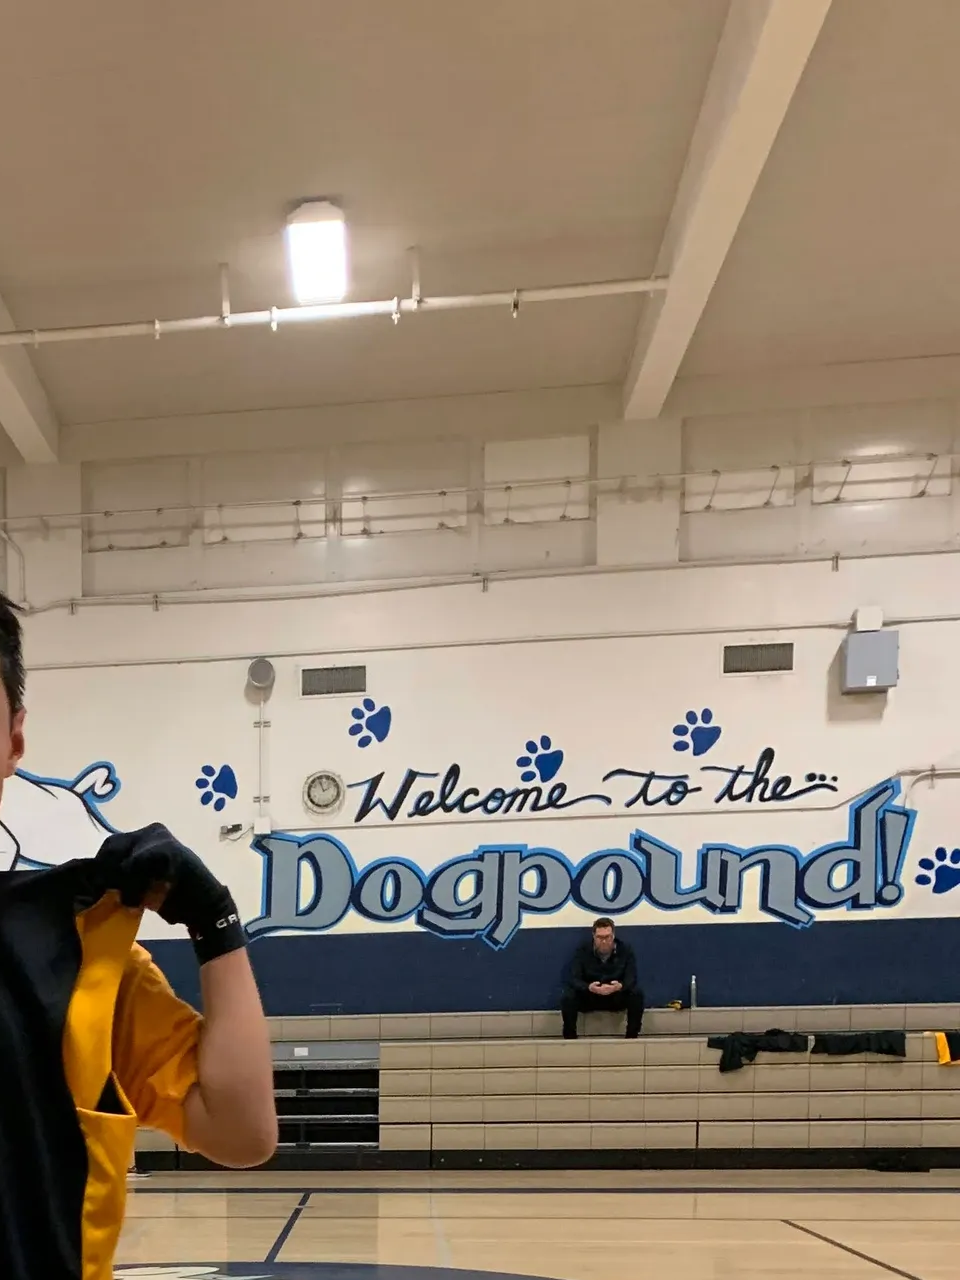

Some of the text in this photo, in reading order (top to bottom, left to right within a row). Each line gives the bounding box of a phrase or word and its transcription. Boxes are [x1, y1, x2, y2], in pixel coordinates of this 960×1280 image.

[346, 762, 612, 823] Welcome
[603, 768, 702, 808] to
[245, 777, 918, 950] Dogpound!
